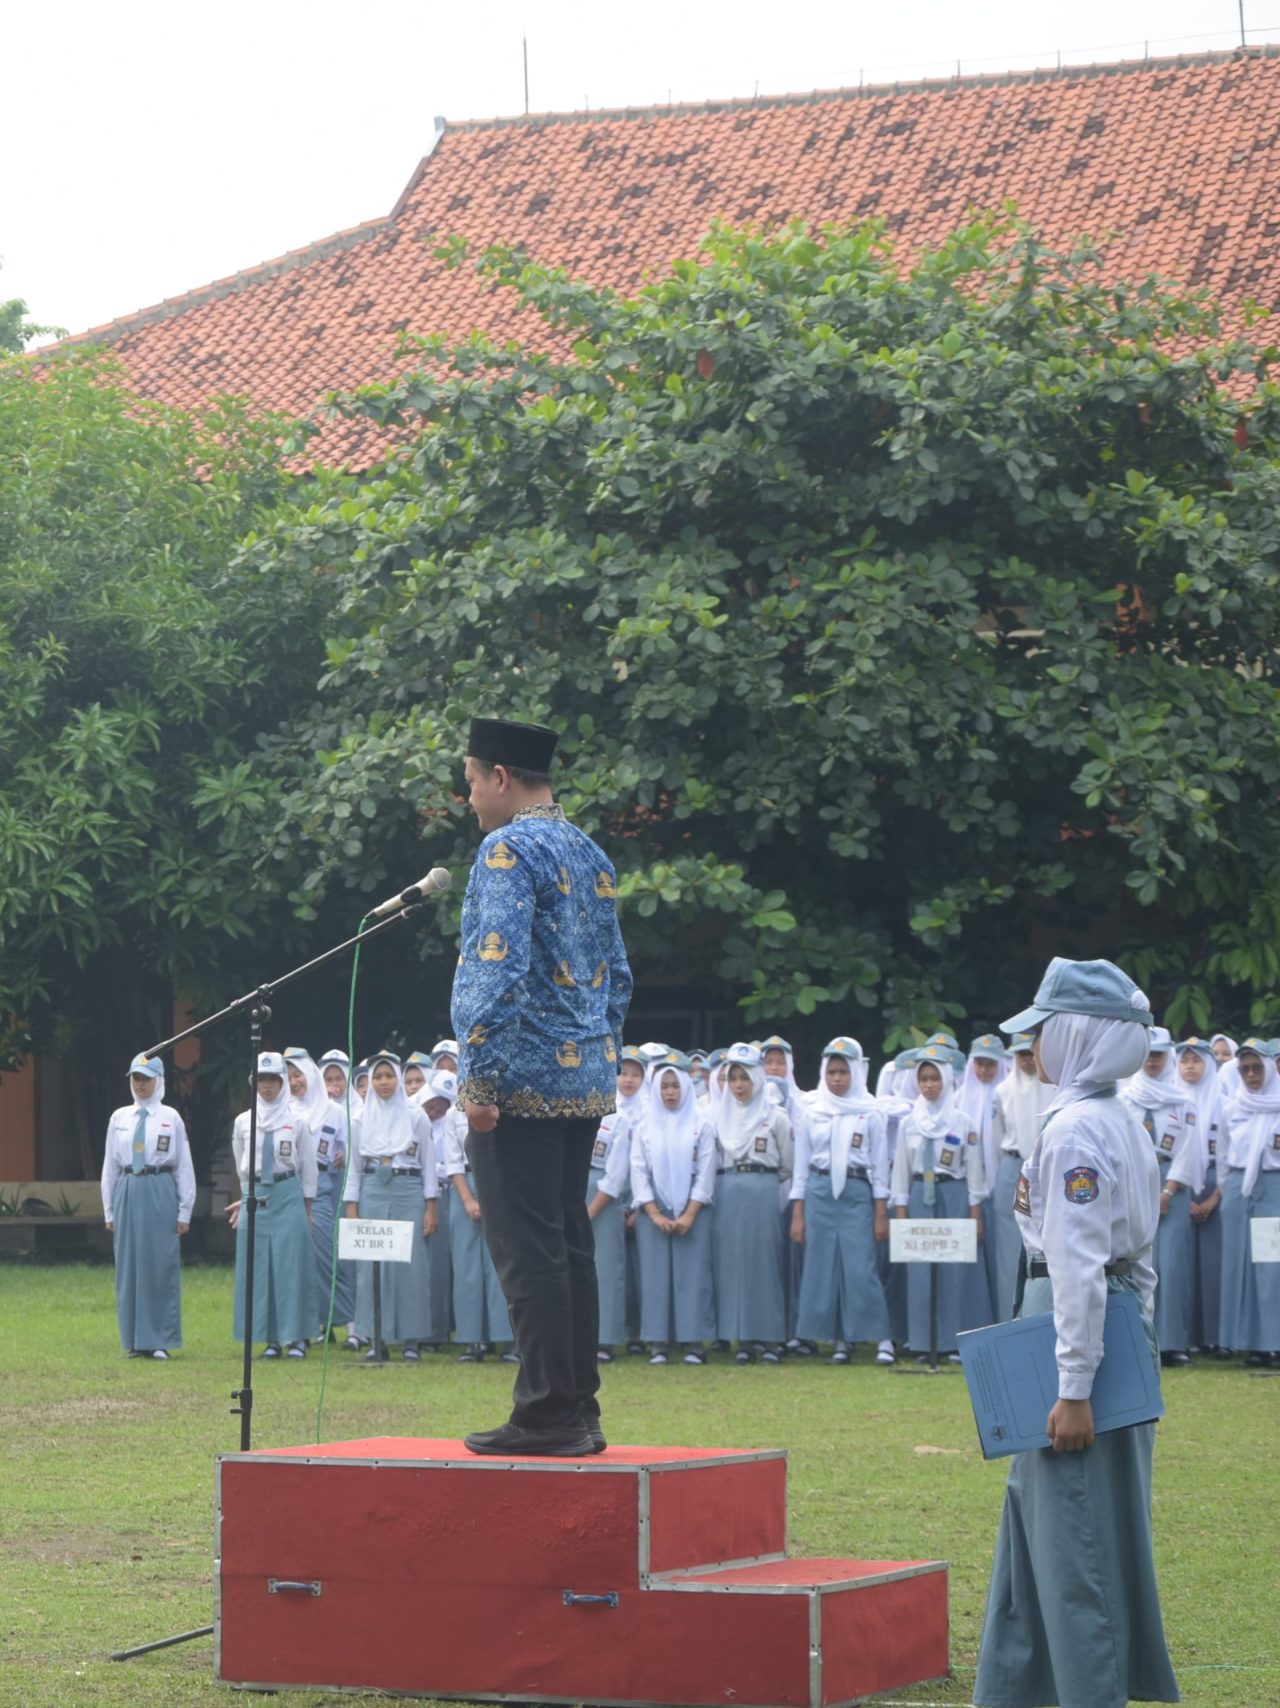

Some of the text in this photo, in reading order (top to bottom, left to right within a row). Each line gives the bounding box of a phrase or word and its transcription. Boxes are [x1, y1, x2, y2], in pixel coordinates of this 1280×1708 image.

[356, 1226, 393, 1236] KELAS
[911, 1226, 952, 1236] KELAS
[354, 1239, 394, 1250] XI BR 1
[904, 1240, 918, 1250] XI
[951, 1240, 960, 1249] 2
